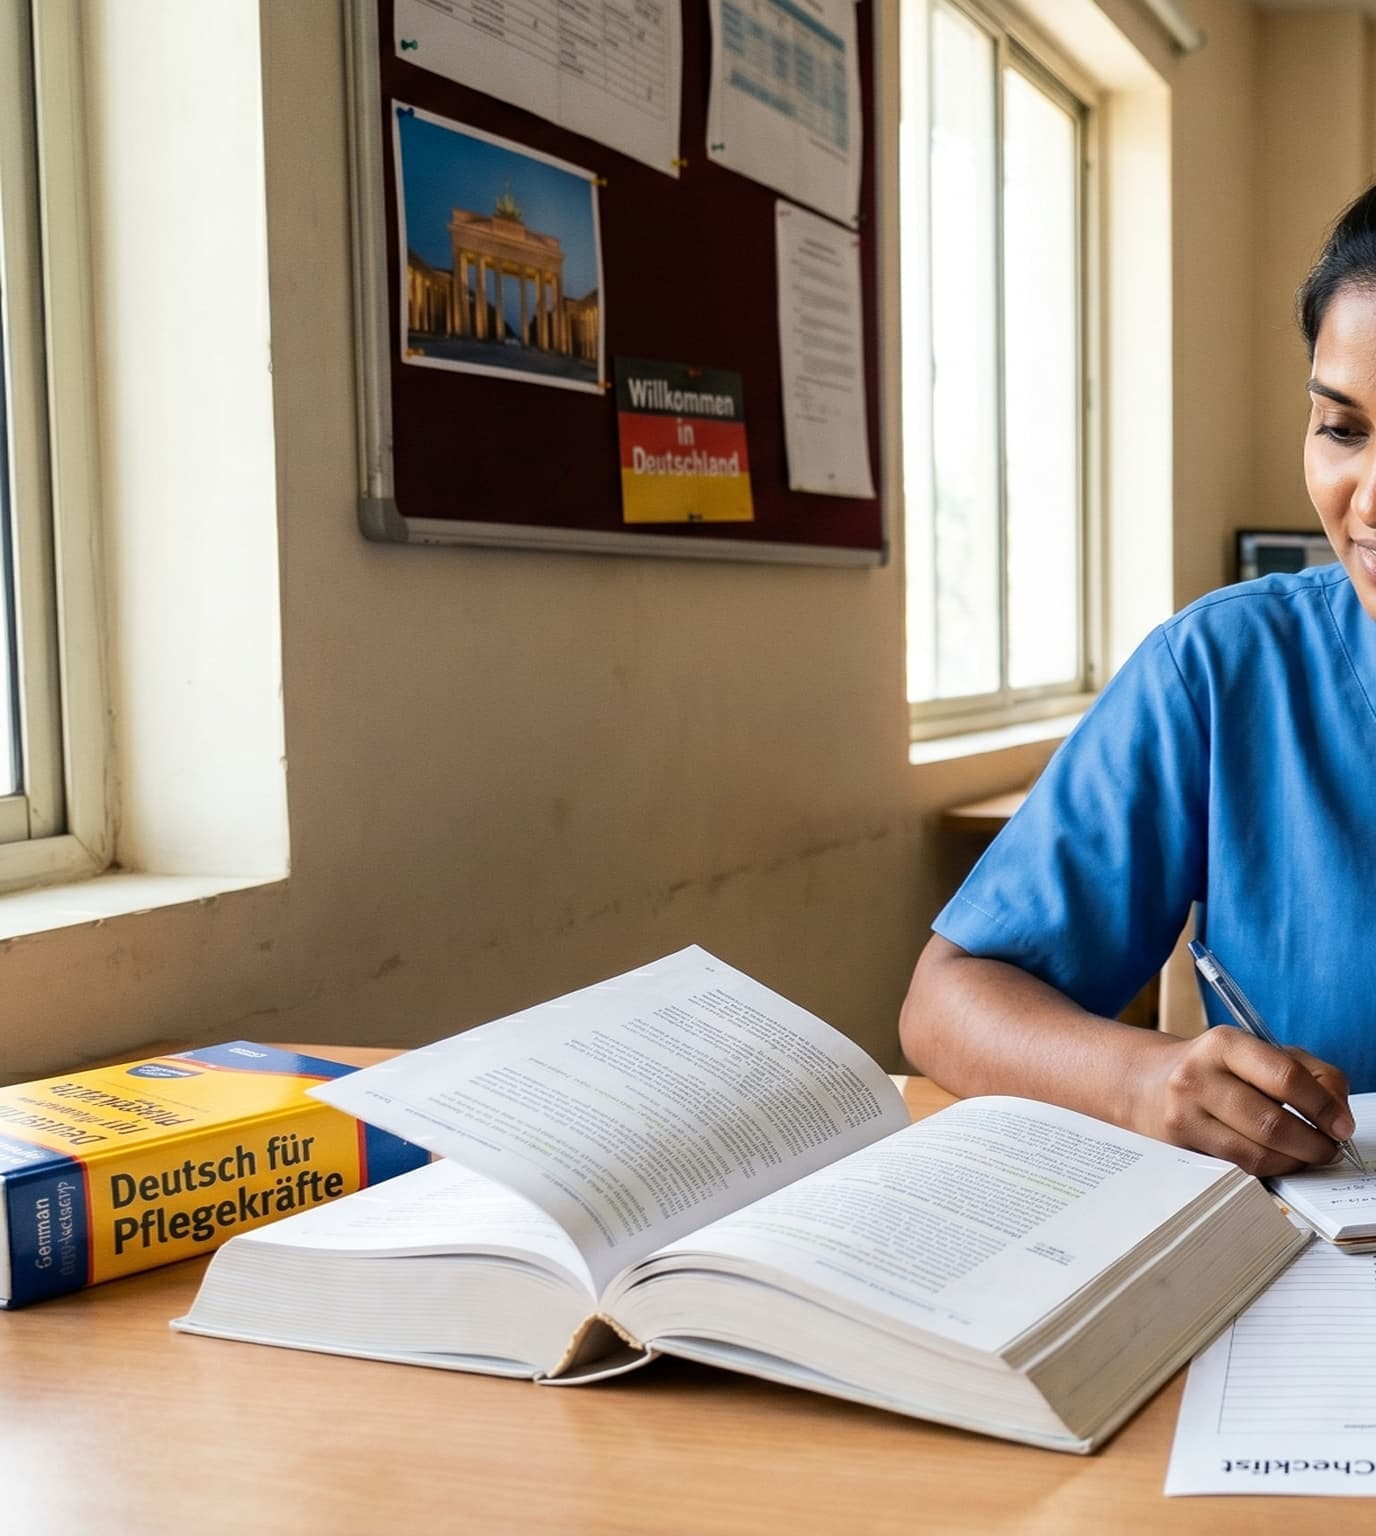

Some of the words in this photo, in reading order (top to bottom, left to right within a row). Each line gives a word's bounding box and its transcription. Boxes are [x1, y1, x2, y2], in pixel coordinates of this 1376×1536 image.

[628, 378, 735, 416] Willkommen
[677, 417, 695, 445] in
[632, 446, 740, 478] Deutschland
[111, 1145, 256, 1209] Deutsch
[266, 1132, 314, 1167] für
[114, 1172, 344, 1255] Pflegekräfte
[1220, 1457, 1376, 1475] Checklist
